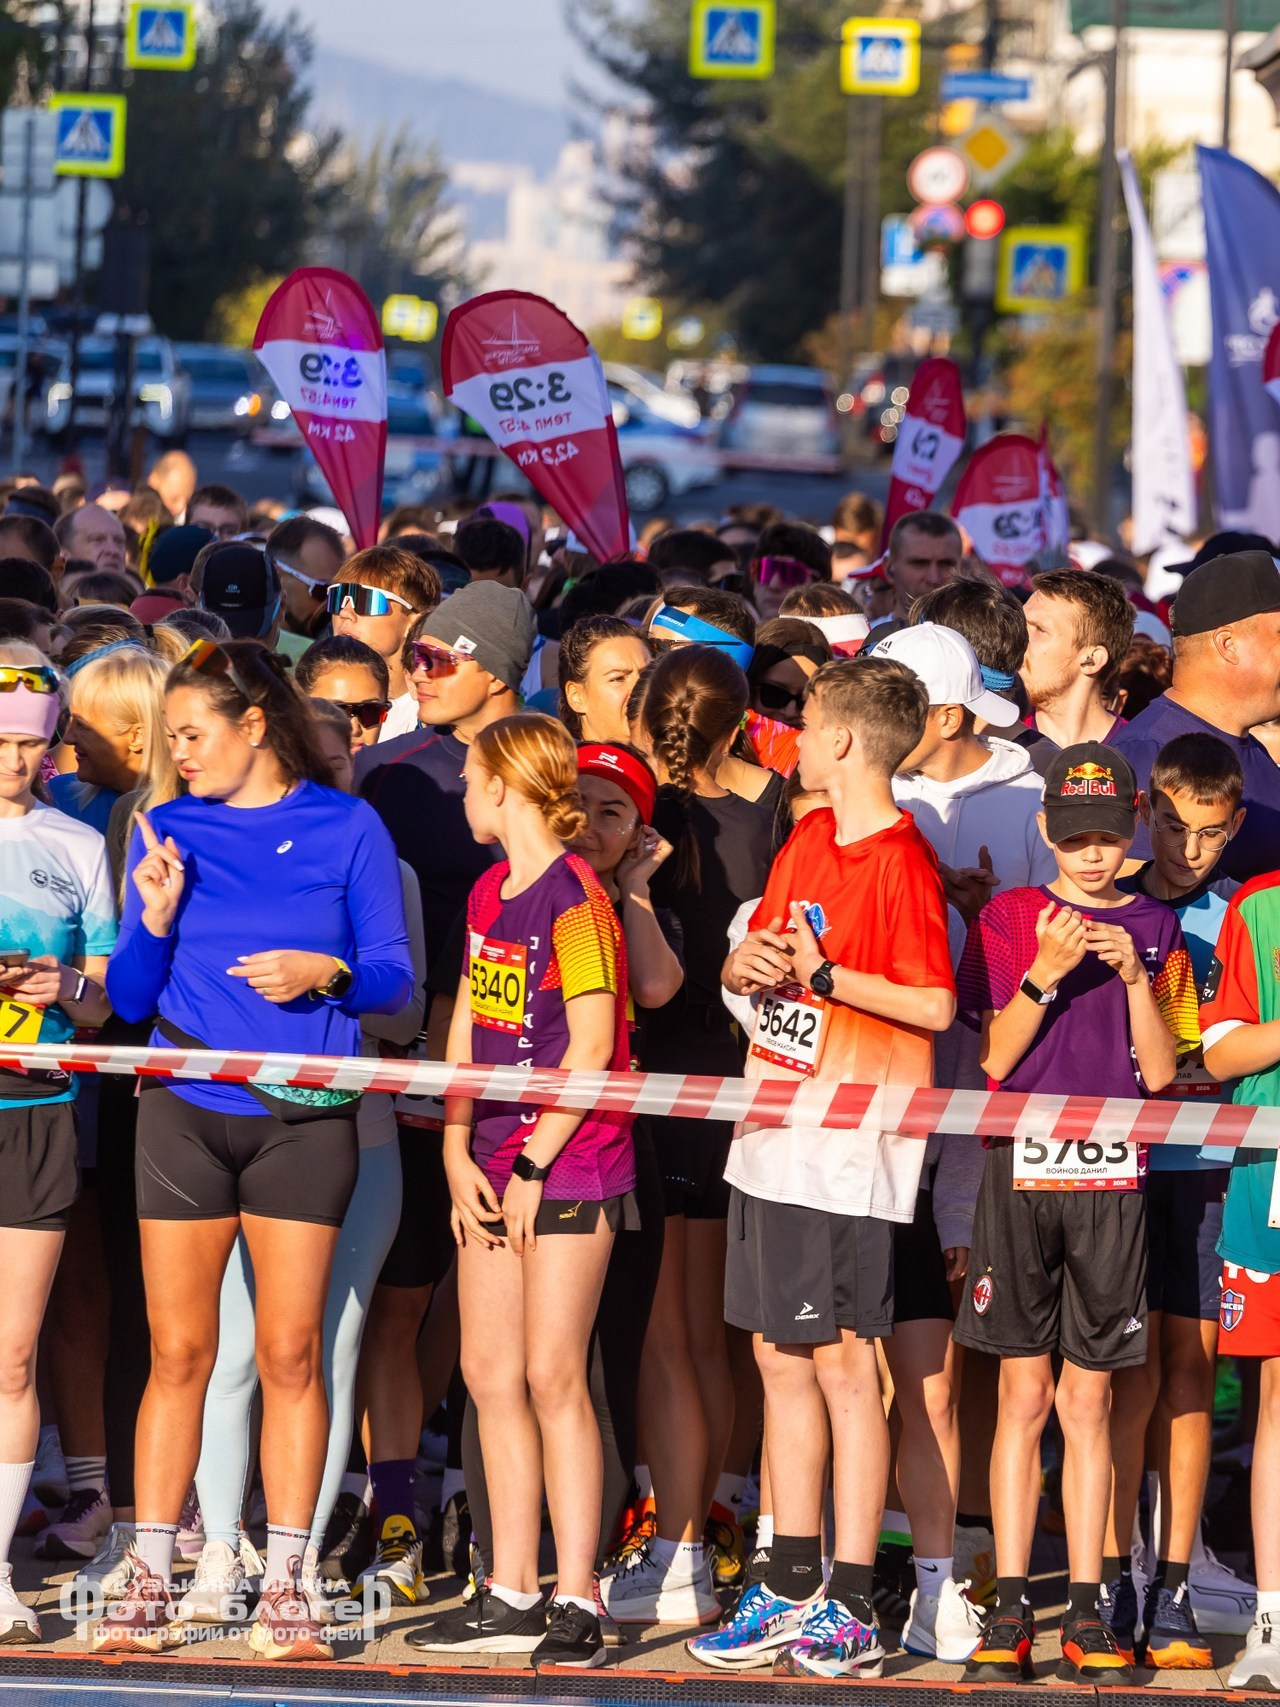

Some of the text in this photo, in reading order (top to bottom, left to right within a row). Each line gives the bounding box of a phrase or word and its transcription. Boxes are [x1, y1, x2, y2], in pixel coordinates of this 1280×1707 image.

[1061, 780, 1117, 796] Red Bull
[471, 962, 520, 1008] 5340
[759, 997, 817, 1049] 5642
[1023, 1135, 1129, 1165] 5763
[1045, 1166, 1108, 1175] ВОЙНОВ ДАНИЛ
[794, 1312, 820, 1320] DEMIX
